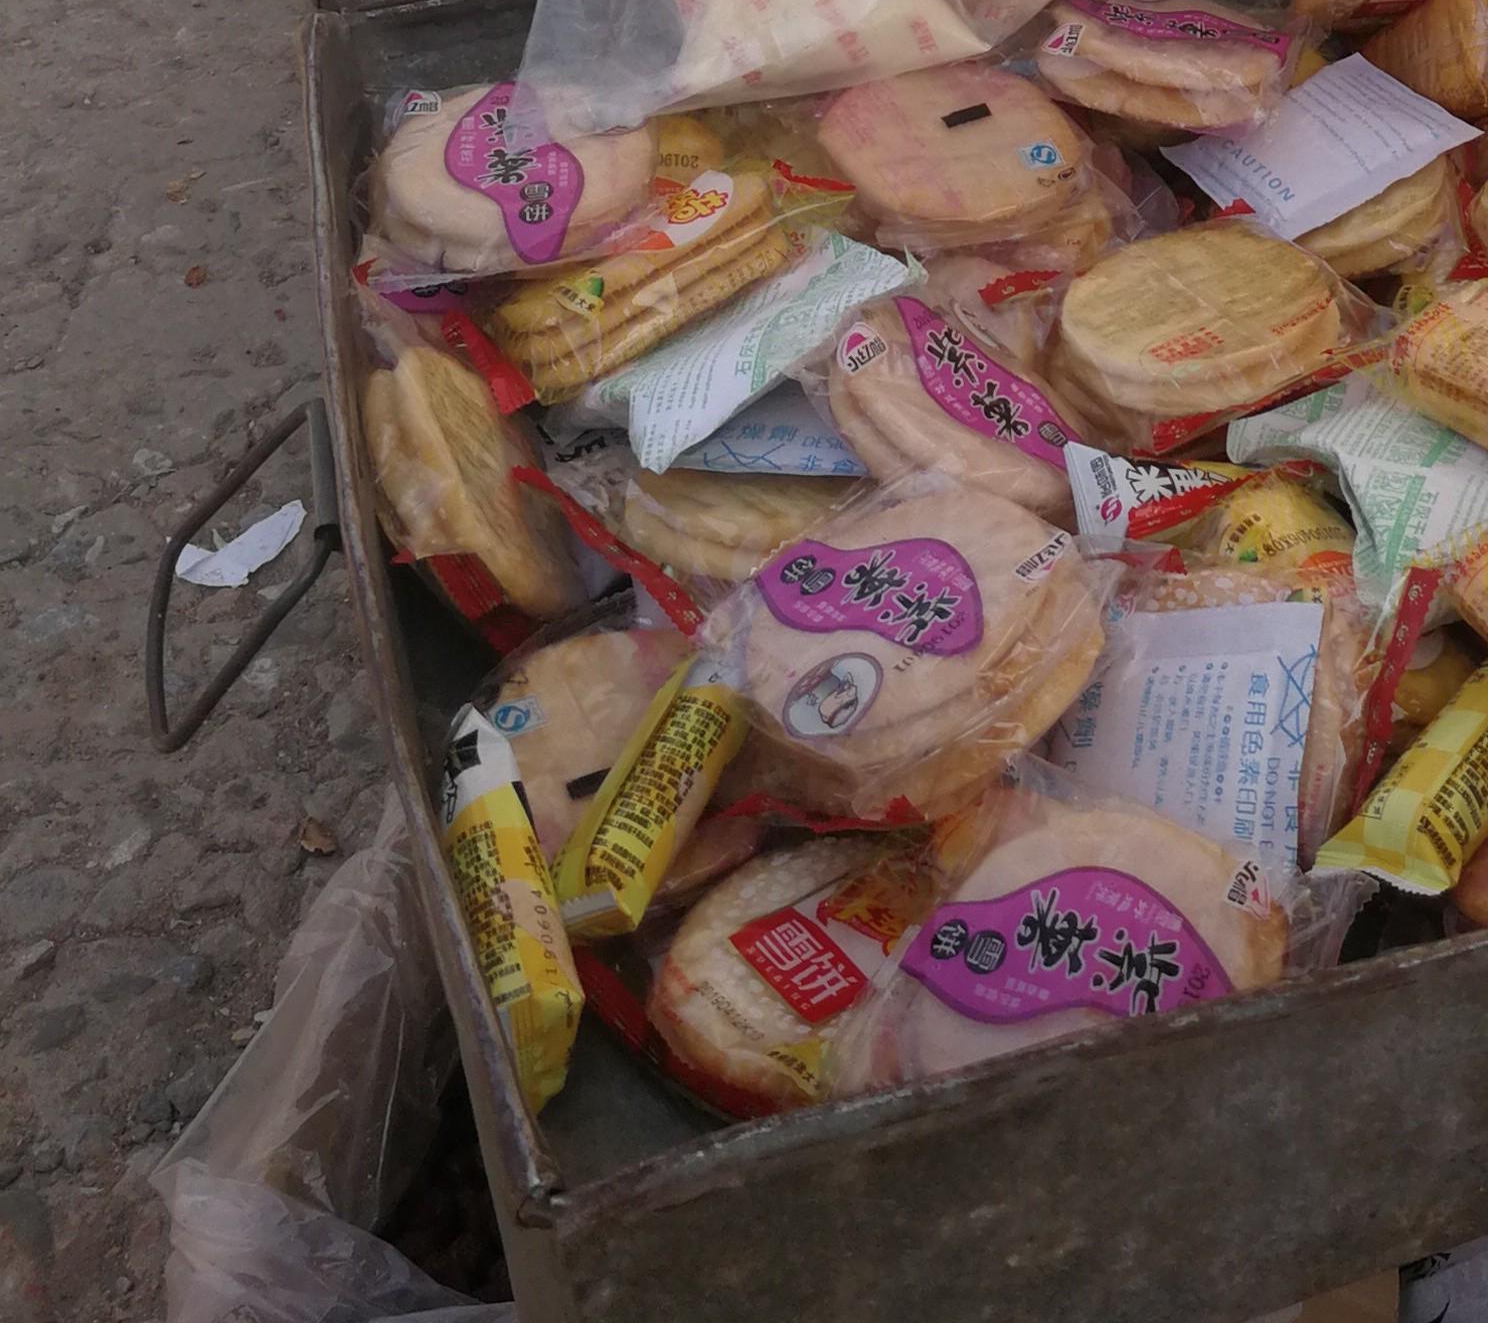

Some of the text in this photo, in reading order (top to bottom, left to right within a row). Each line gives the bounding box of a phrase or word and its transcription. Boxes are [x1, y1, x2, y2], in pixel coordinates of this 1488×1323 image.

[1221, 139, 1296, 203] CAUTION
[1233, 672, 1270, 841] 食用色素印刷
[754, 919, 858, 1005] 雪饼
[930, 918, 1007, 975] 雪饼
